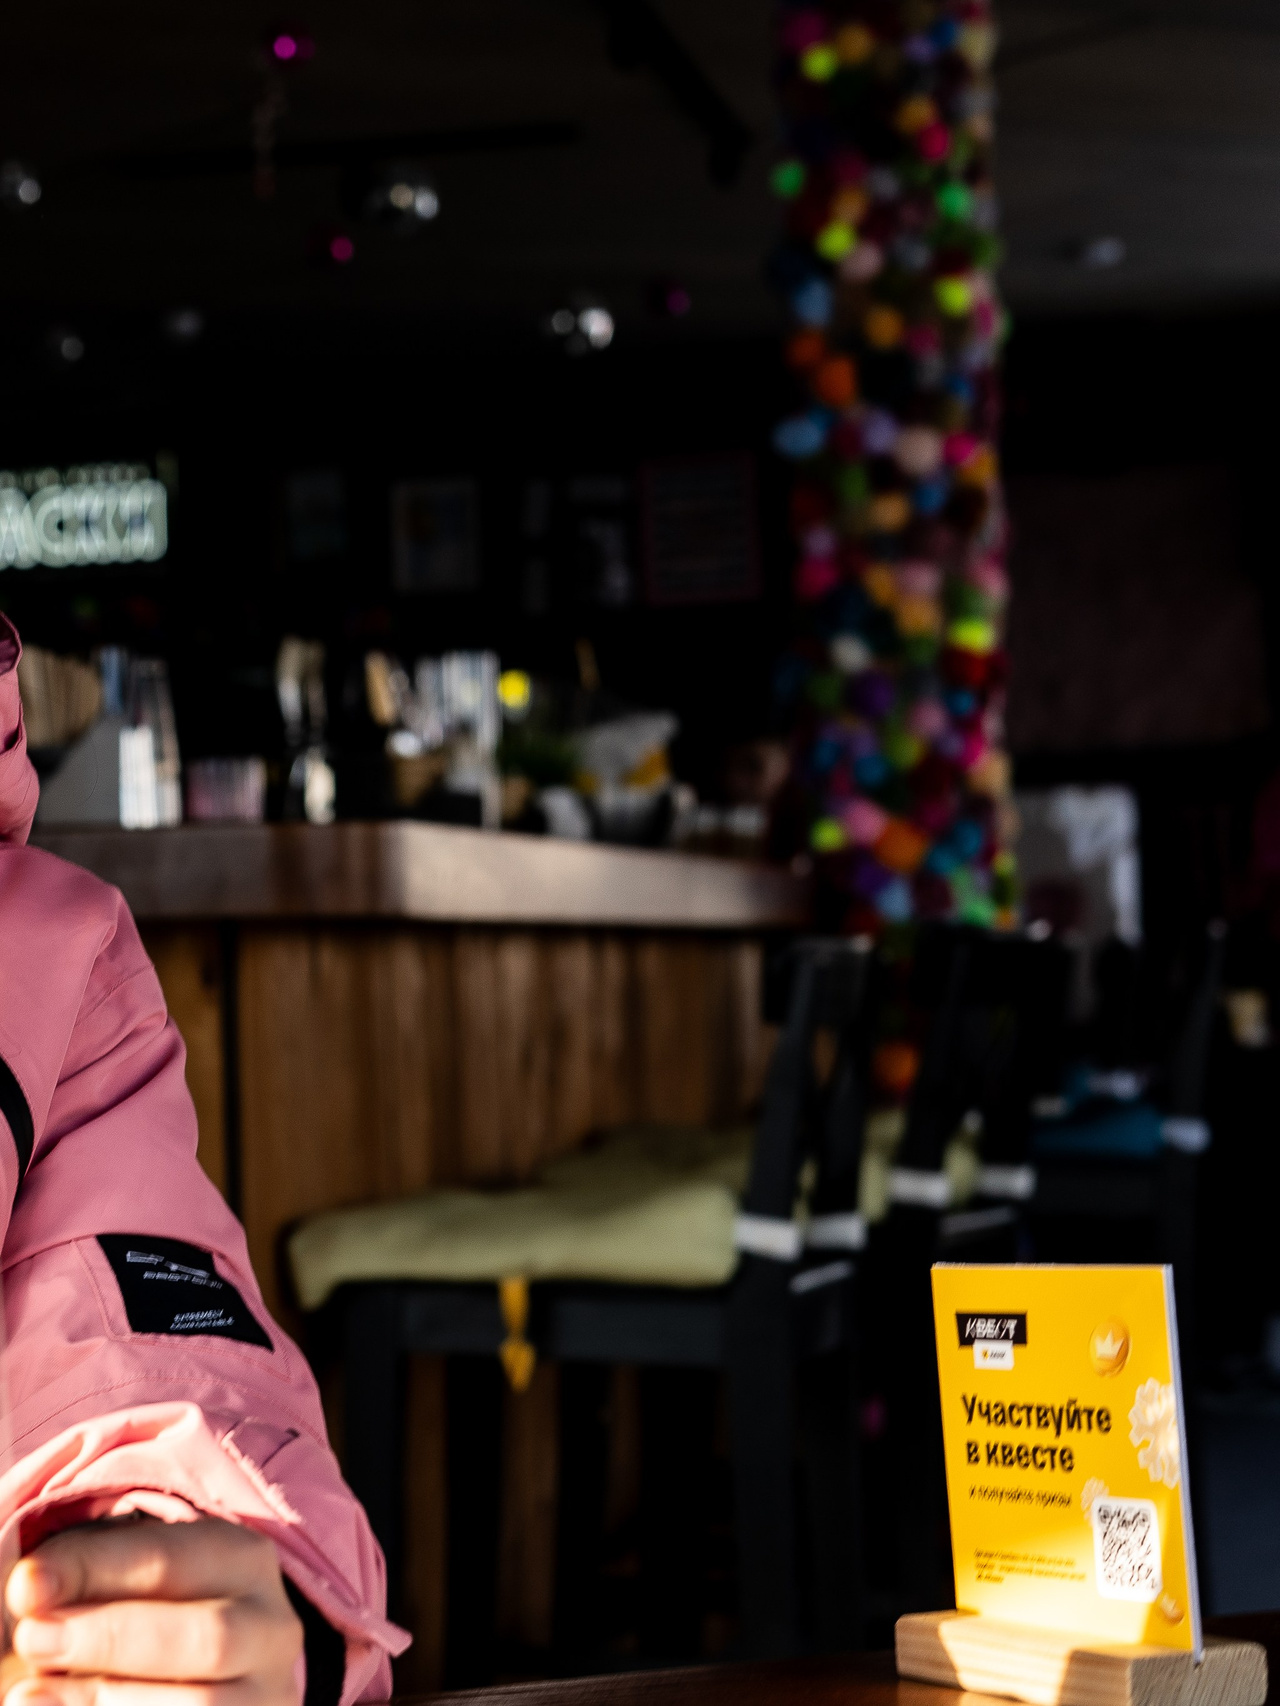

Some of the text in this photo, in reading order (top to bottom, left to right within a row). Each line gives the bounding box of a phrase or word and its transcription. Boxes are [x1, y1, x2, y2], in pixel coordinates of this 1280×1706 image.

[965, 1318, 1018, 1339] КВЕСТ
[961, 1393, 1113, 1439] Участвуйте
[966, 1438, 1075, 1473] в квесте
